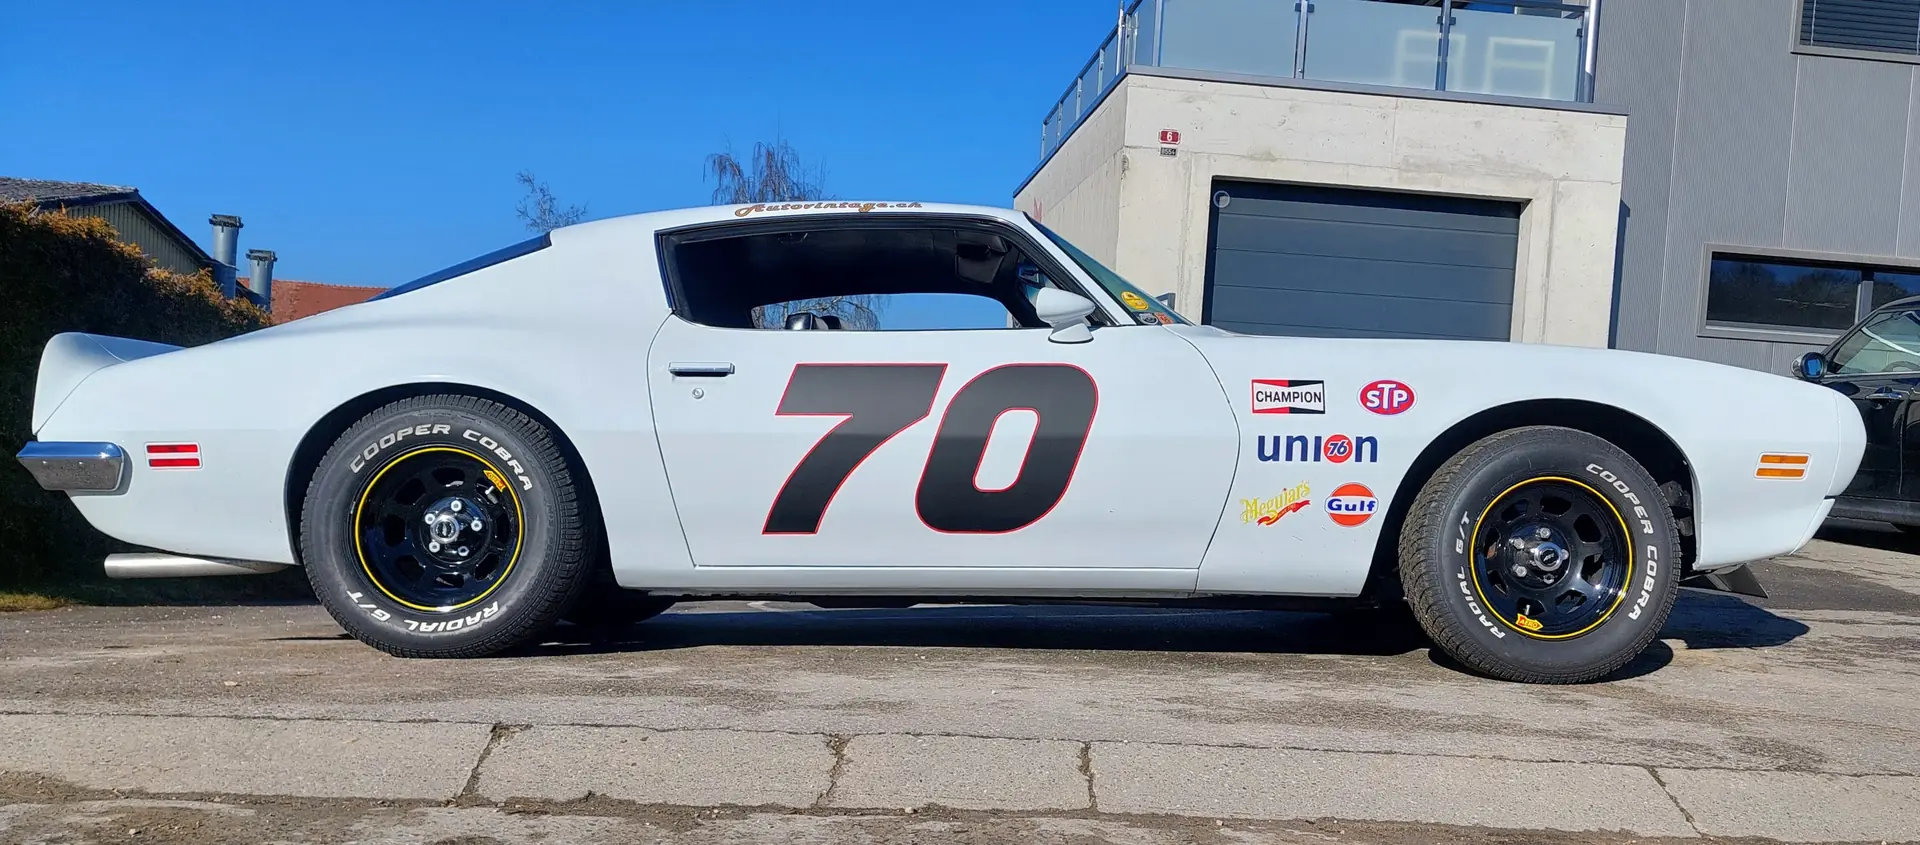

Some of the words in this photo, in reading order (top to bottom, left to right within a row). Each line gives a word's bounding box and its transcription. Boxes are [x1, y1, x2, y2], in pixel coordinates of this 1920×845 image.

[1166, 131, 1173, 142] 6
[734, 201, 922, 217] Autovintage.ch
[1255, 390, 1322, 403] CHAMPION
[1366, 383, 1408, 410] STP
[349, 424, 451, 474] COOPER
[462, 429, 533, 491] COBRA
[761, 362, 1099, 535] 70
[1327, 440, 1348, 456] 76
[1240, 479, 1310, 525] Meguiar's
[1327, 498, 1376, 512] Gulf
[1455, 510, 1471, 554] G/T
[1586, 463, 1654, 535] COOPER
[1628, 545, 1658, 621] COBRA
[346, 589, 392, 622] G/T
[404, 601, 499, 632] RADIAL
[1456, 565, 1506, 639] RADIAL
